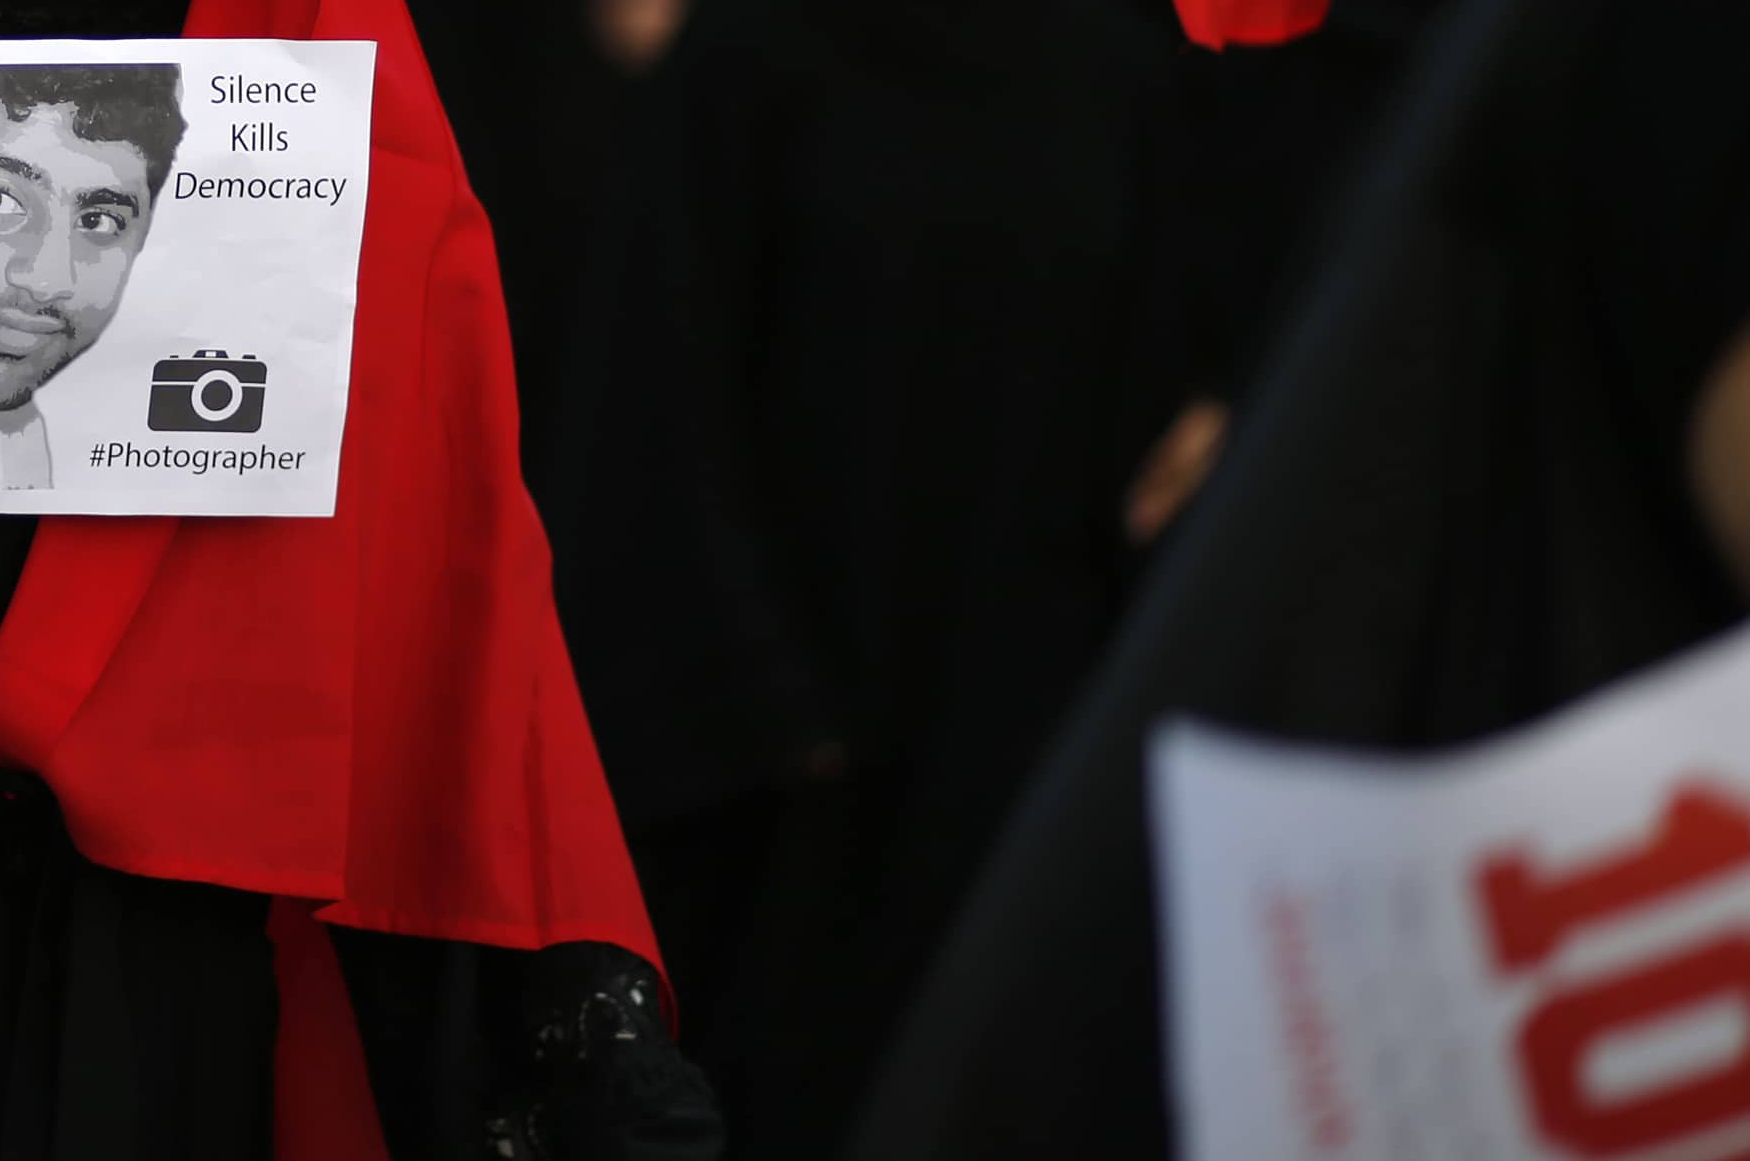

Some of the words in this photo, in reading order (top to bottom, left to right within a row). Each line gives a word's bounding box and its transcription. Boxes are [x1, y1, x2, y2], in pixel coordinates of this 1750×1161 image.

[210, 74, 317, 105] Silence
[231, 122, 289, 152] Kills
[174, 171, 347, 206] Democracy
[89, 441, 307, 475] #Photographer
[1472, 777, 1750, 1161] 10
